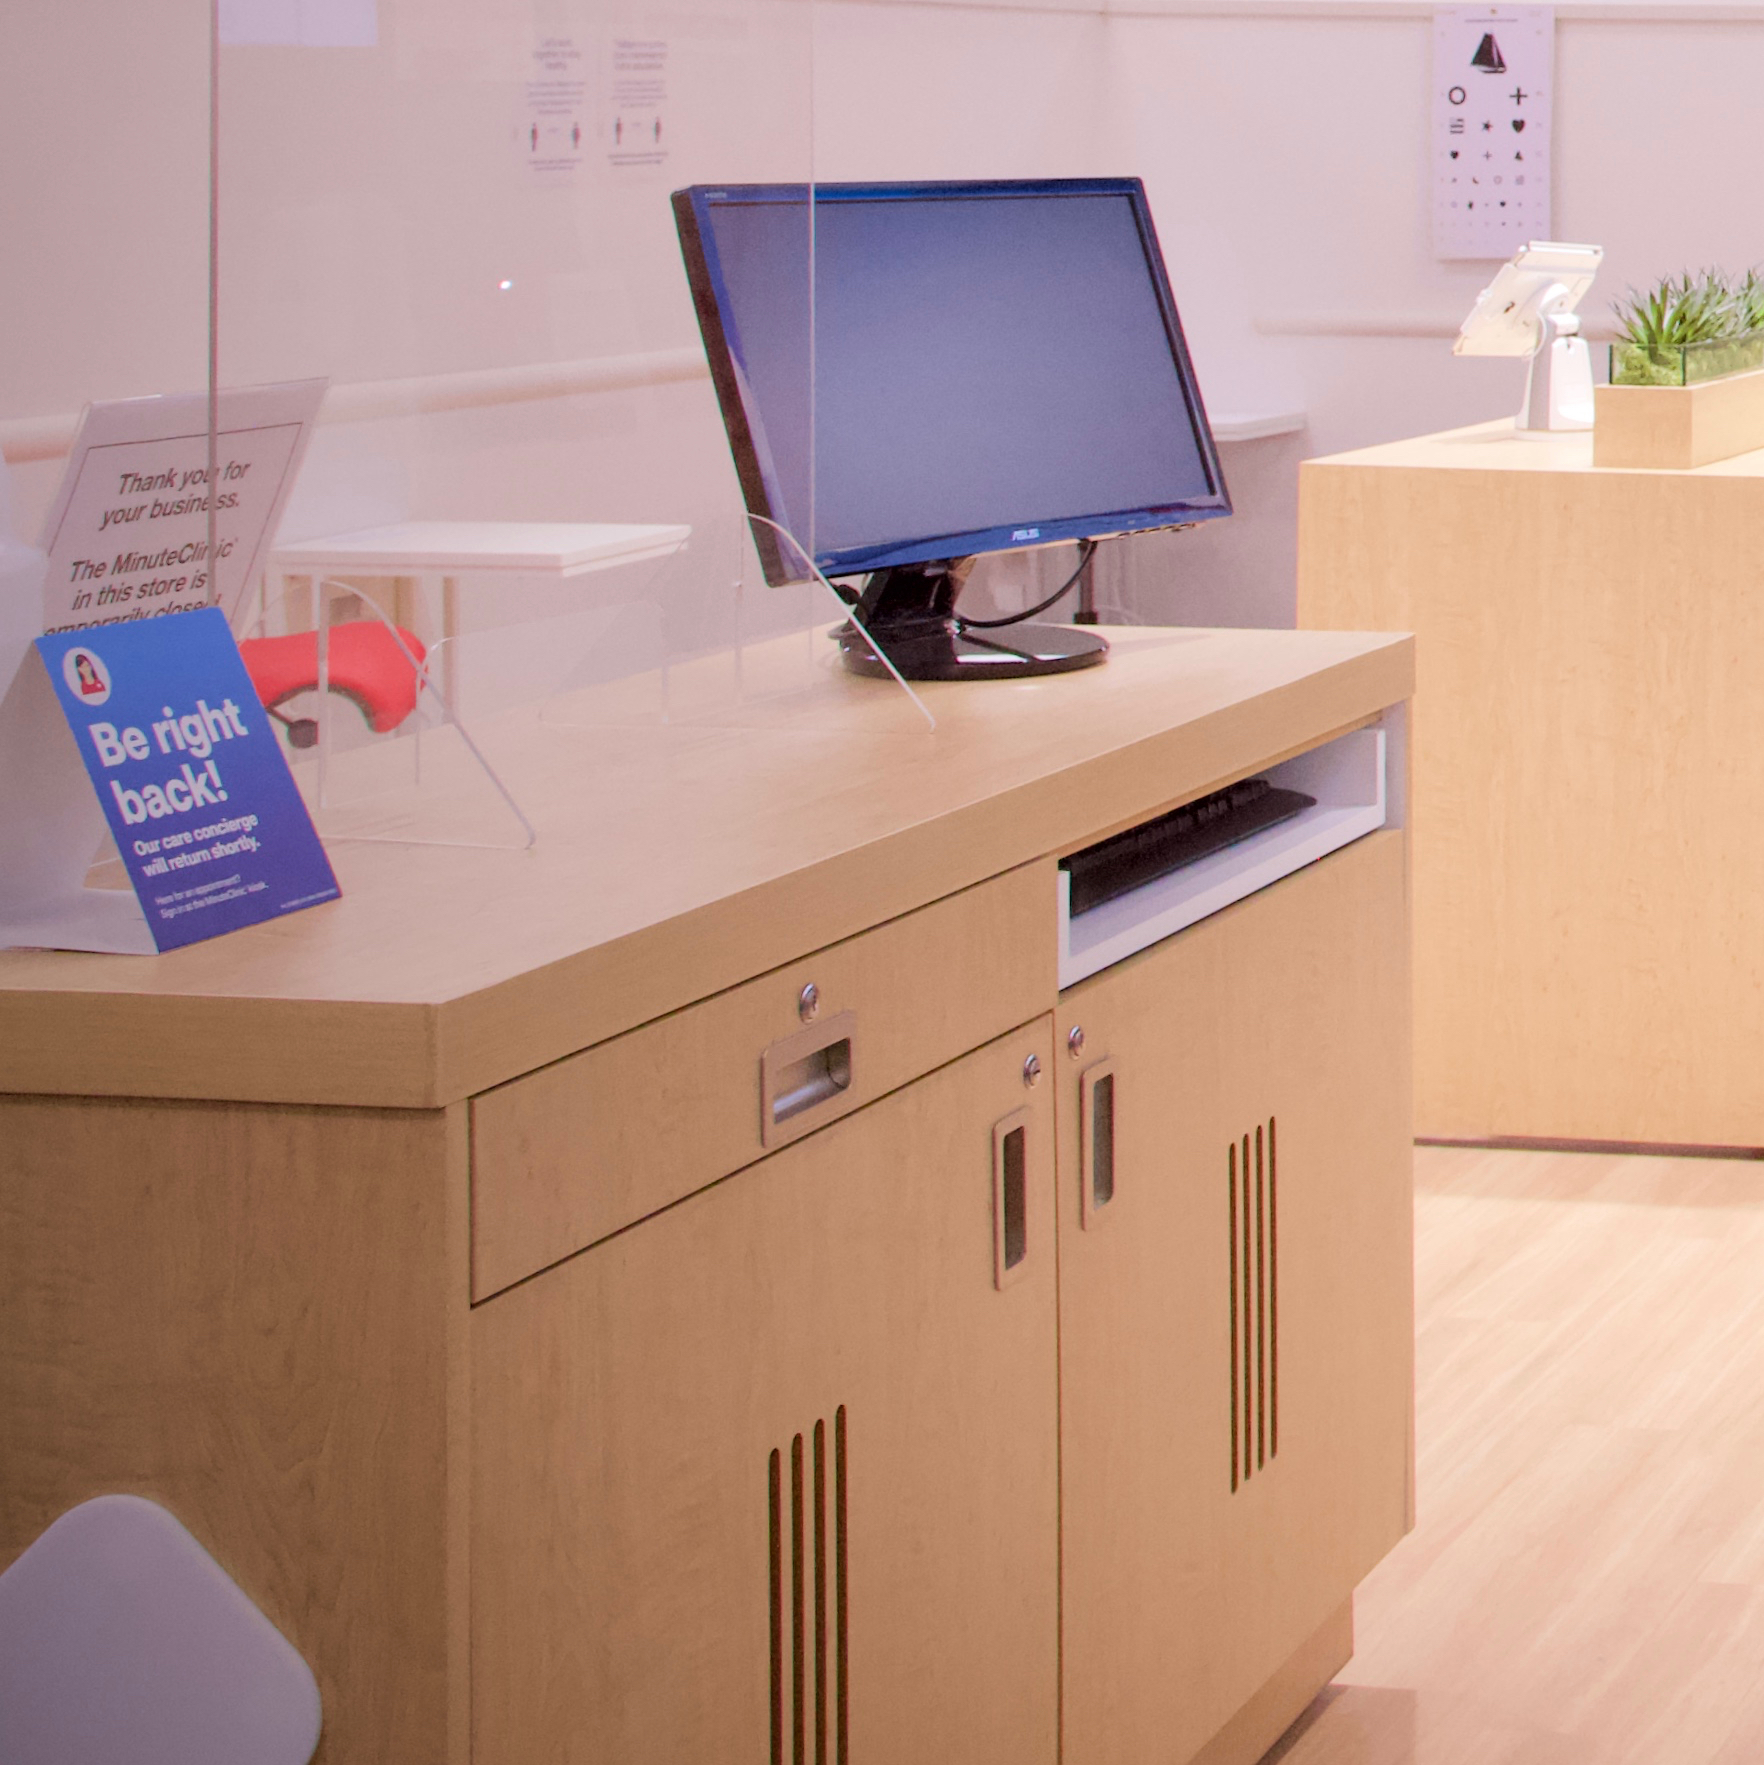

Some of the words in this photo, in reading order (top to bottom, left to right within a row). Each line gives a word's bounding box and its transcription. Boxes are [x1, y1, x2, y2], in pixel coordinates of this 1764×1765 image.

[119, 468, 178, 495] Thank
[223, 460, 252, 481] for
[98, 503, 148, 531] your
[70, 561, 107, 582] The
[71, 590, 92, 611] in
[97, 584, 132, 607] this
[136, 575, 187, 599] store
[190, 569, 208, 591] is
[88, 722, 150, 767] Be
[152, 698, 249, 759] right
[110, 760, 229, 826] back!
[133, 840, 161, 857] Our
[162, 831, 193, 850] care
[193, 814, 259, 841] concierge
[142, 857, 169, 877] will
[168, 848, 211, 871] return
[211, 834, 261, 860] shortly.
